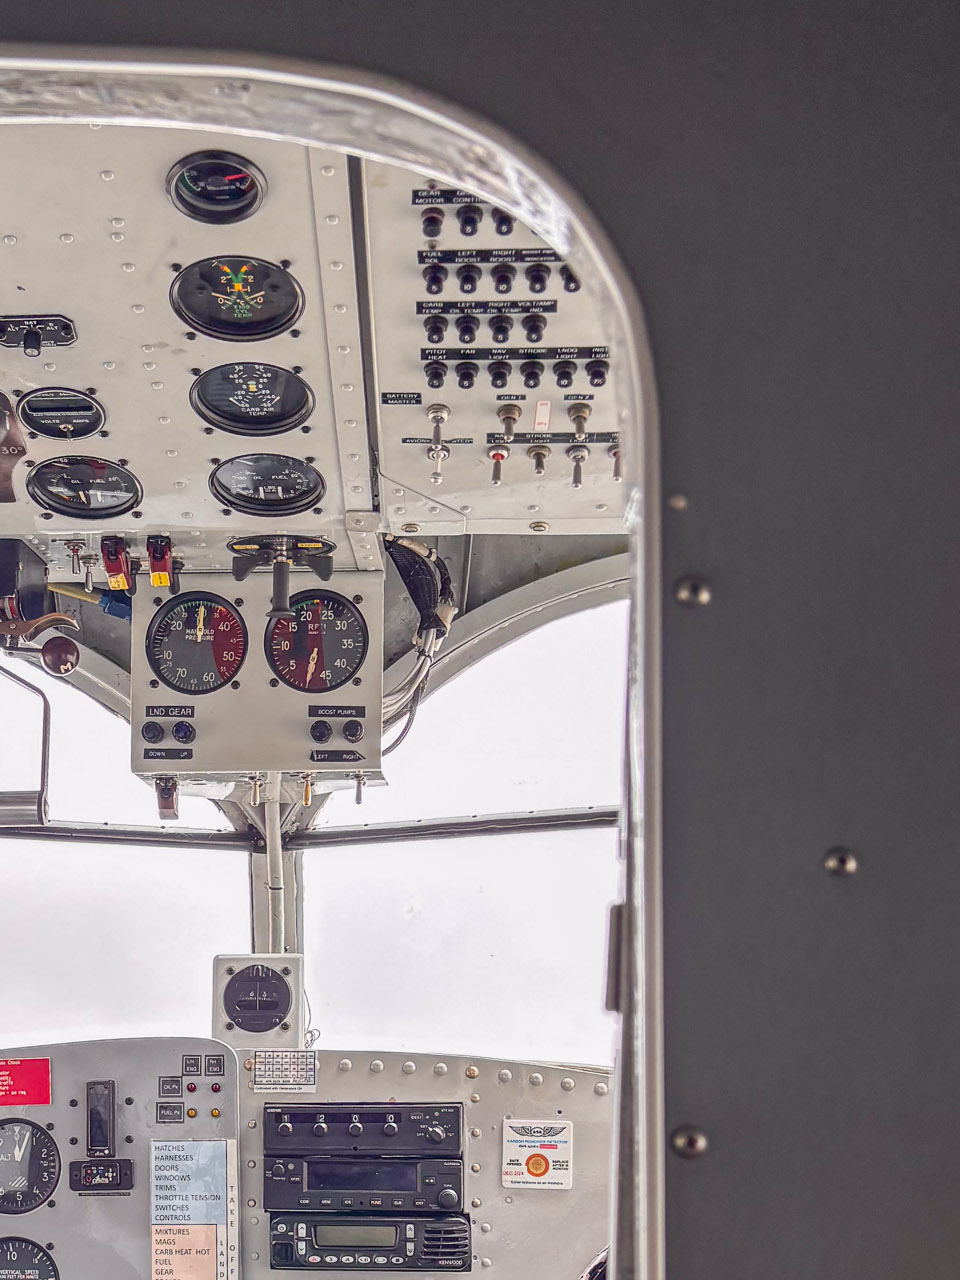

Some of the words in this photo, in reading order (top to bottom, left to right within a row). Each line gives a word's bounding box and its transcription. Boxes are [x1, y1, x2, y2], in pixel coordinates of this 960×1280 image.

[300, 612, 312, 620] 20
[321, 611, 334, 620] 25
[171, 621, 182, 630] 20
[218, 622, 230, 631] 40
[289, 622, 298, 632] 15
[335, 621, 347, 630] 30
[281, 641, 290, 650] 10
[342, 639, 354, 648] 35
[163, 651, 172, 659] 10
[222, 652, 234, 661] 50
[290, 660, 296, 669] 5
[334, 659, 346, 668] 40
[176, 668, 187, 677] 70
[203, 672, 215, 682] 60
[320, 670, 332, 680] 45
[42, 1149, 47, 1158] 2
[42, 1173, 48, 1181] 3
[16, 1192, 22, 1200] 5
[7, 1252, 17, 1260] 10
